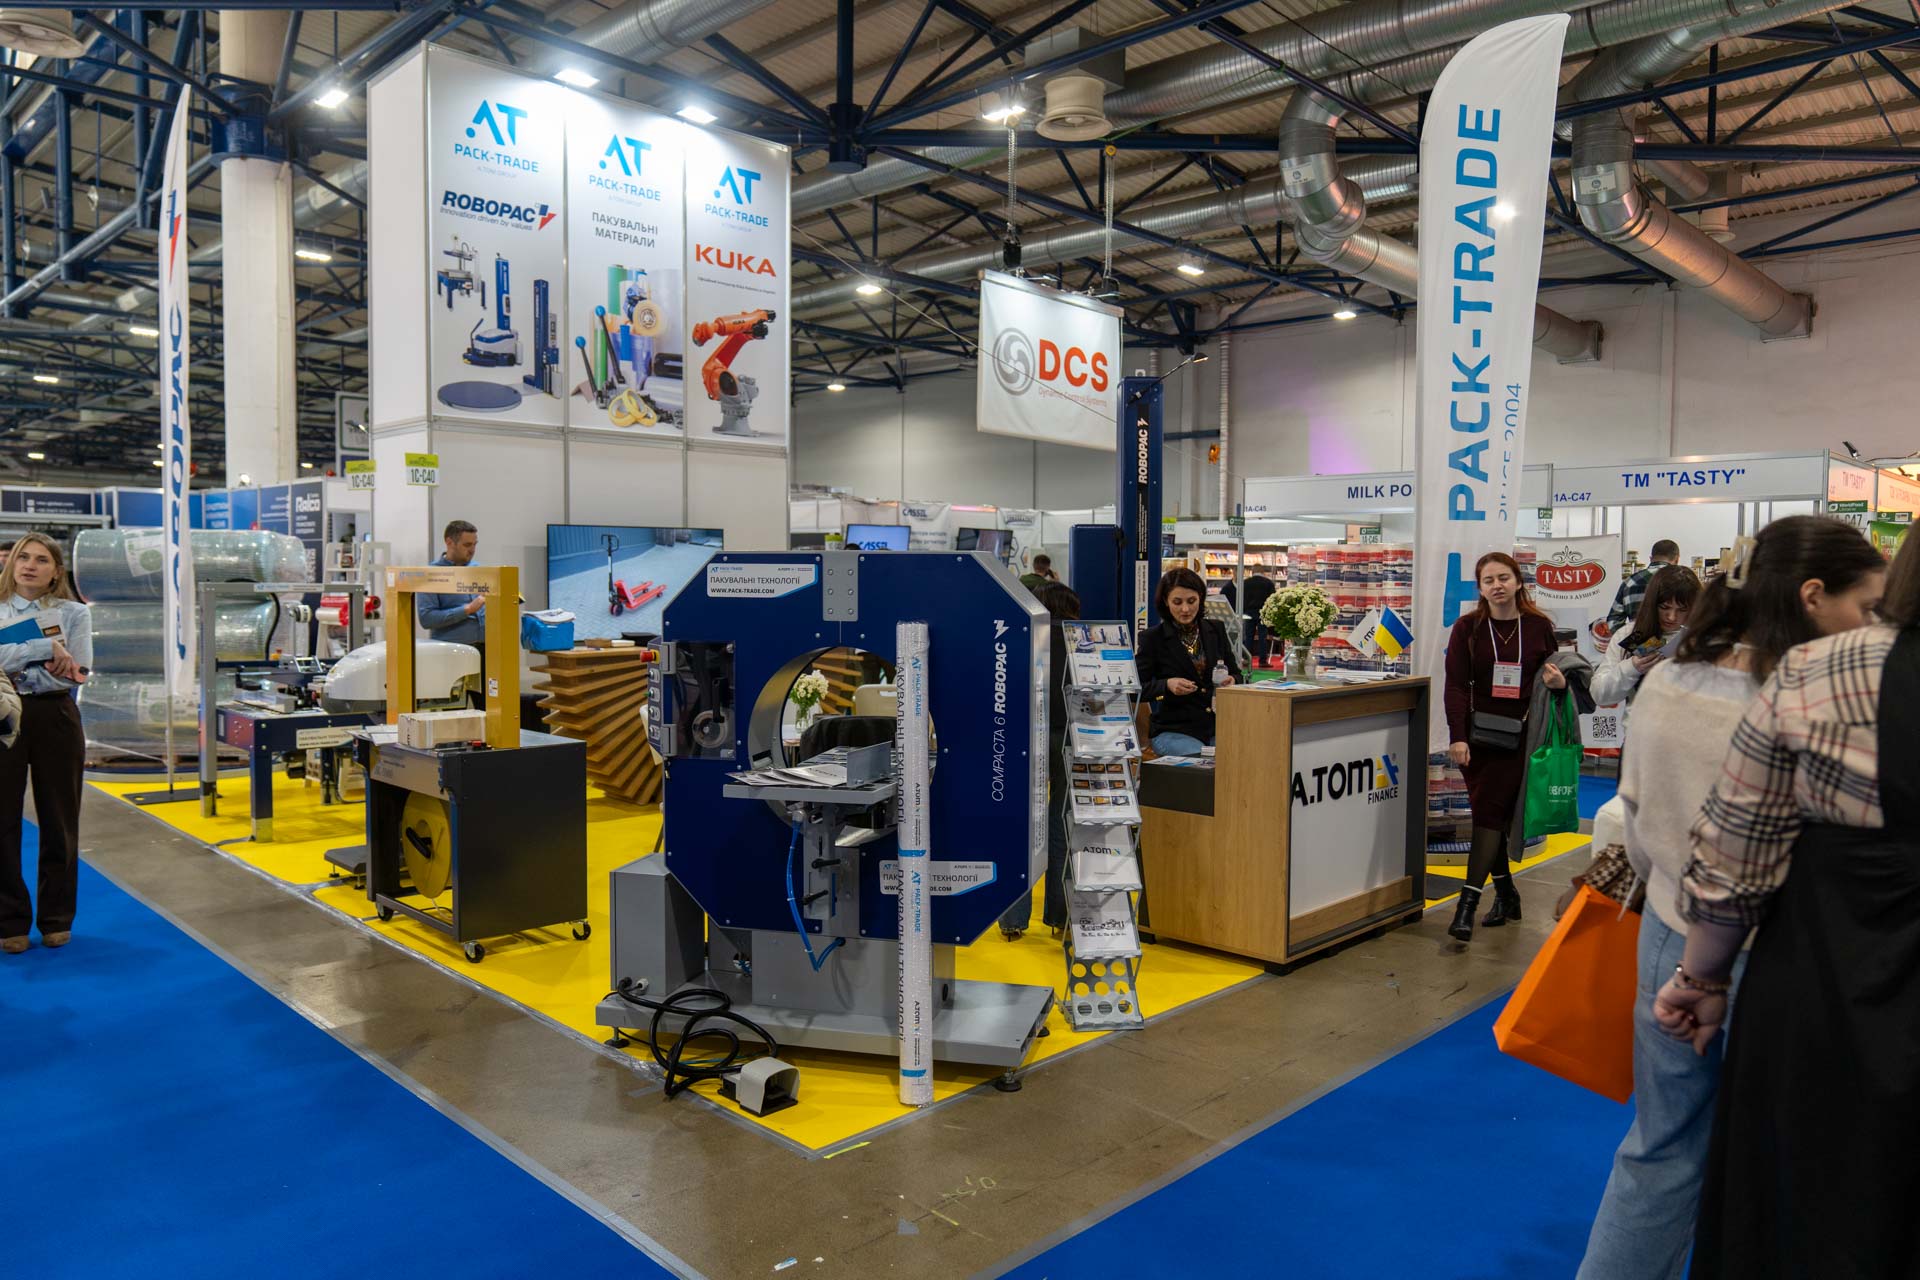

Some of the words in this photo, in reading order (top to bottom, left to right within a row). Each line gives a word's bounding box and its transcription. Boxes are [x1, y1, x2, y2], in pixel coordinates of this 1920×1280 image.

[454, 142, 540, 173] PACK-TRADE
[589, 174, 661, 202] PACK-TRADE
[440, 206, 477, 220] Innovation
[477, 212, 499, 225] driven
[500, 218, 509, 228] by
[510, 219, 534, 231] values
[442, 190, 536, 223] ROBOPAC
[704, 203, 769, 228] PACK-TRADE
[592, 211, 659, 236] ПАКУВАЛЬНІ
[595, 226, 656, 249] МАТЕРІАЛИ
[695, 243, 777, 278] KUKA
[1448, 103, 1501, 522] PACK-TRADE
[1039, 338, 1109, 393] DCS
[1137, 428, 1148, 484] ROBOPAC
[1622, 473, 1650, 488] TM
[1656, 468, 1746, 487] "TASTY"
[1347, 484, 1385, 499] MILK
[1553, 492, 1592, 503] 1A-C47
[710, 576, 756, 584] ПАКУВАЛЬНІ
[757, 576, 800, 584] ТЕХНОЛОГІЇ
[1541, 569, 1594, 584] TASTY
[994, 642, 1008, 714] ROBOPAC
[896, 656, 905, 740] ПАКУВАЛЬНІ
[994, 716, 1005, 725] 6
[992, 728, 1006, 802] COMPACTA
[898, 743, 906, 824] ТЕХНОЛОГІЇ
[1292, 757, 1374, 807] A.TOM
[1367, 786, 1399, 805] FINANCE
[932, 874, 979, 883] ТЕХНОЛОГІЇ
